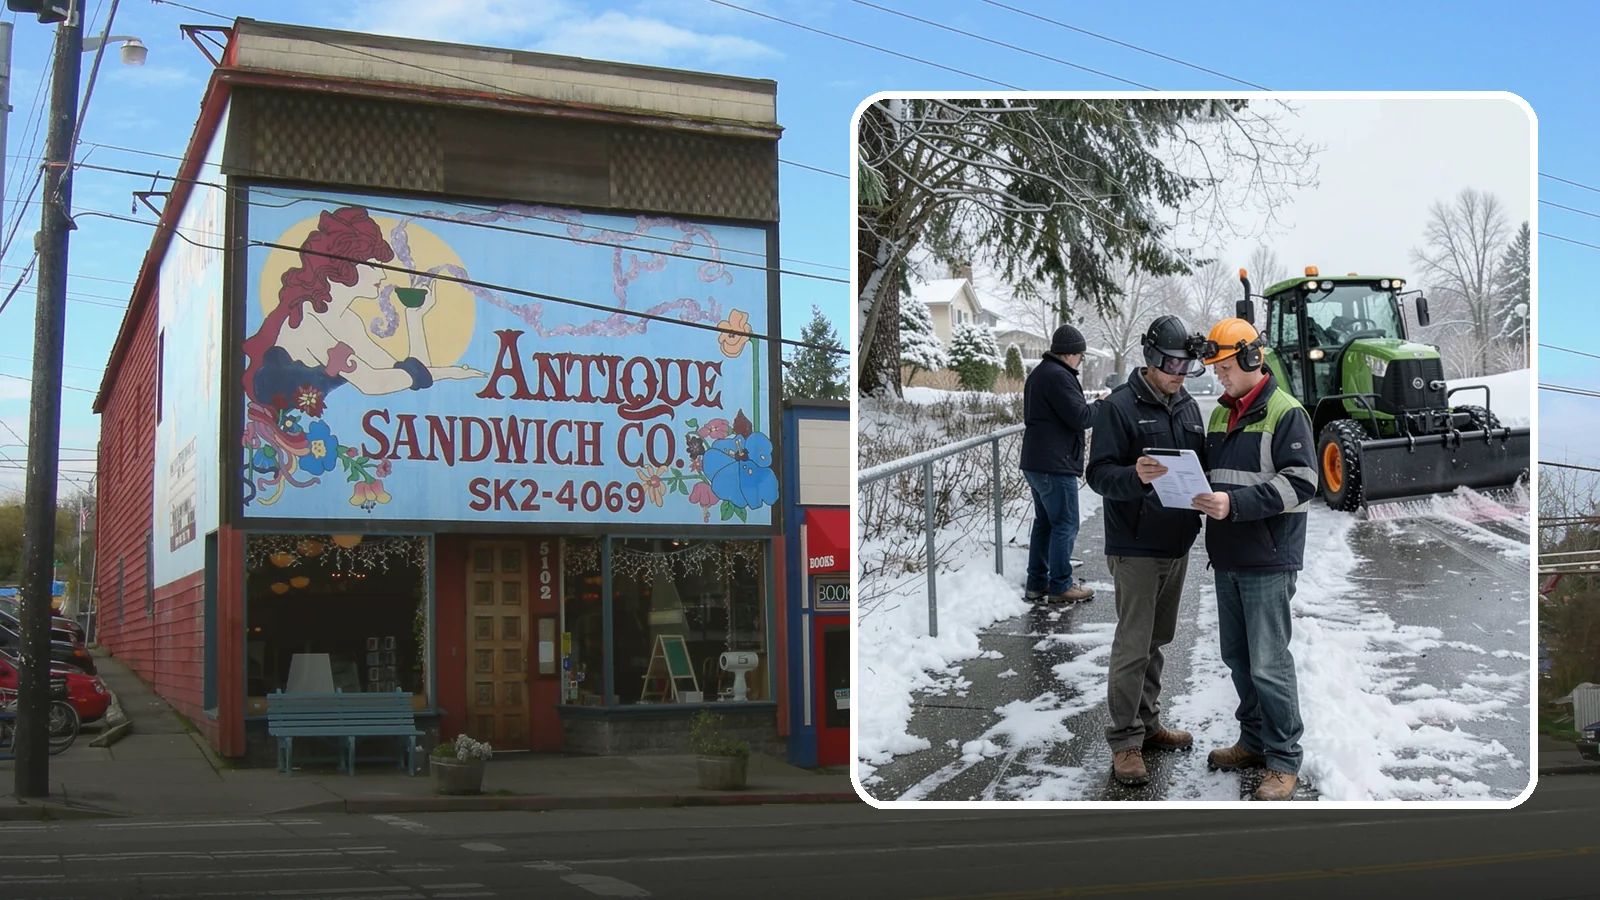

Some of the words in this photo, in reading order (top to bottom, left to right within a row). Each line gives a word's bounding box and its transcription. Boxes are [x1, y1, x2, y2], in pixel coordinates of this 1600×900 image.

[475, 329, 725, 421] ANTIQUE
[361, 408, 604, 467] SANDWICH
[616, 421, 685, 469] CO.
[469, 476, 646, 512] SK2-4069
[540, 541, 552, 600] 5102
[809, 555, 835, 569] BOOKS
